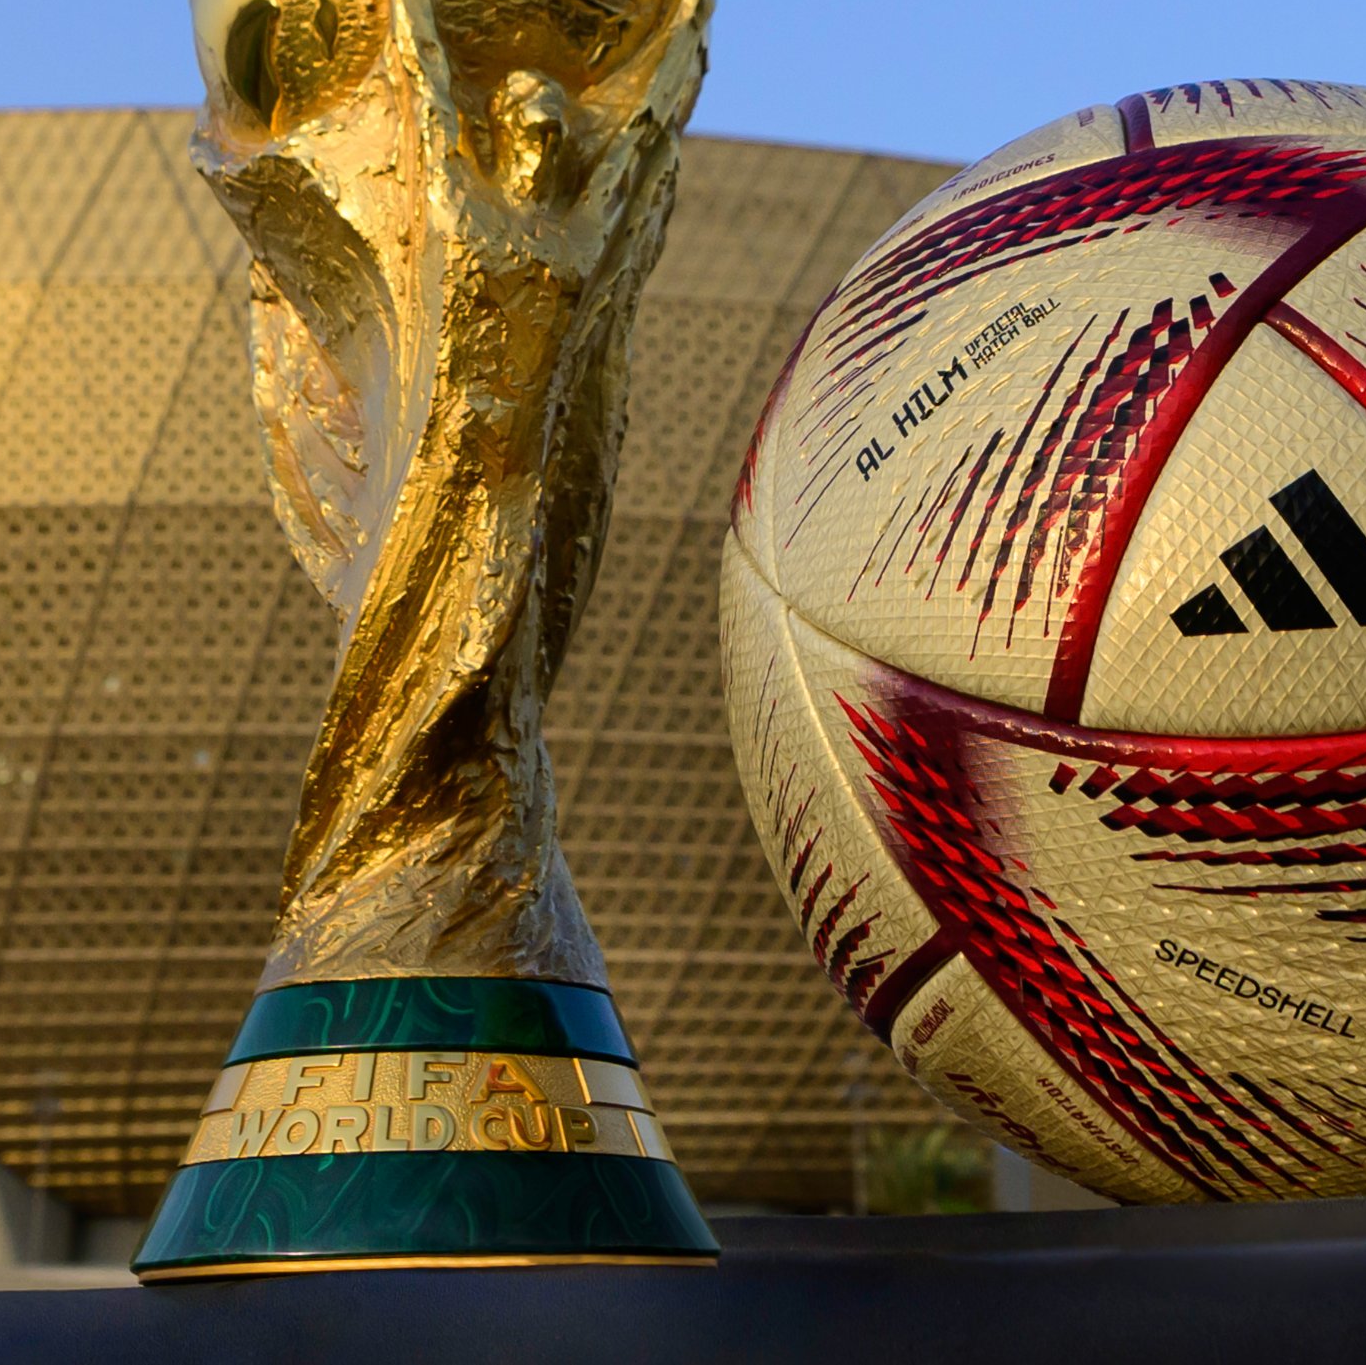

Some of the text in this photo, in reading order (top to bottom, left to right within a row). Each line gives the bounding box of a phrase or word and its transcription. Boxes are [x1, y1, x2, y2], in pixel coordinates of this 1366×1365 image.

[964, 302, 1033, 357] OFFICIAL
[971, 297, 1062, 370] MATCH BALL
[856, 356, 969, 482] AL HILM
[1155, 939, 1356, 1039] SPEEDSHELL
[281, 1052, 549, 1106] FIFA
[229, 1104, 600, 1159] WORLD CUP
[1037, 1078, 1140, 1164] INSPIRATION
